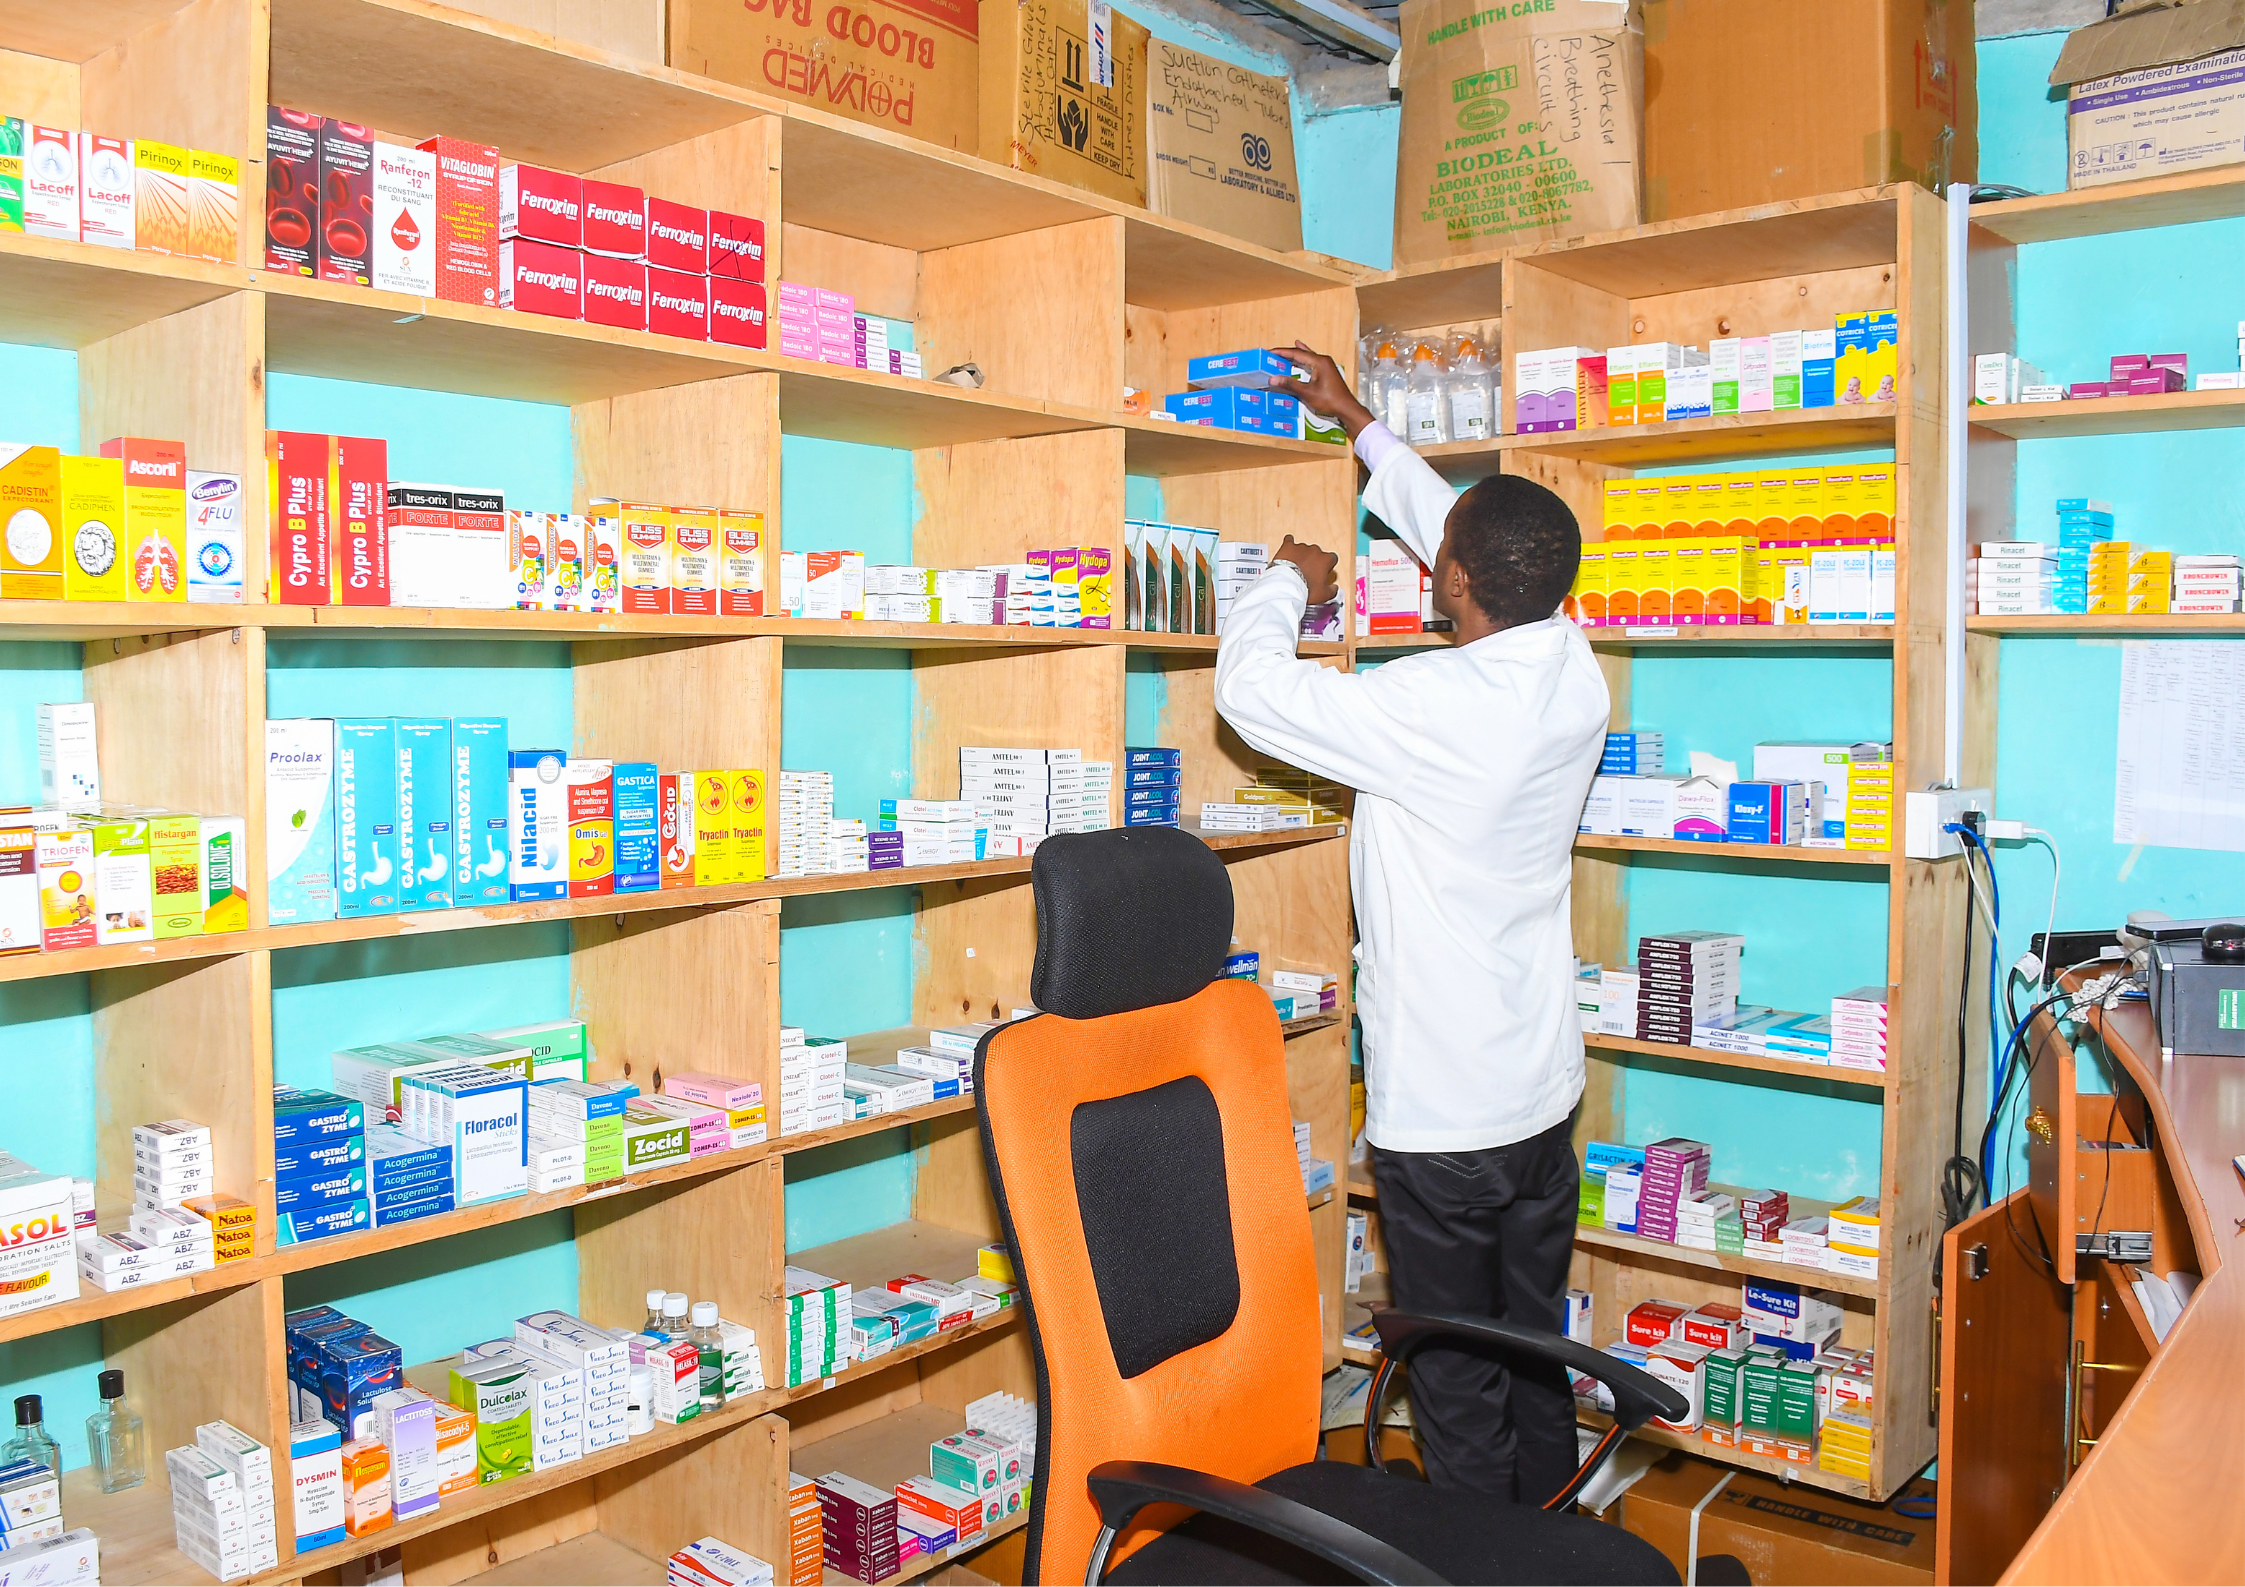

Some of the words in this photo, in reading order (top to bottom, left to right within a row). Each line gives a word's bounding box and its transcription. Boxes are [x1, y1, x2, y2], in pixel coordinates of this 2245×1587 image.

[1428, 18, 1468, 45] HANDLE
[1470, 6, 1506, 29] WITH
[1512, 0, 1556, 19] CARE
[826, 5, 935, 69] BLOOD
[765, 35, 836, 64] DEVICES
[850, 60, 914, 90] MEDICAL
[2078, 80, 2109, 94] Latex
[2112, 66, 2172, 86] Powdered
[762, 48, 914, 126] POLYMED
[1559, 37, 1588, 142] Breathing
[2093, 94, 2114, 106] Single
[2115, 92, 2128, 102] Use
[2140, 82, 2190, 96] Ambidextrous
[2202, 72, 2244, 84] Non-Sterile
[1097, 96, 1118, 114] FRAGILE
[1152, 102, 1166, 112] BOX
[2095, 114, 2126, 124] CAUTION
[2133, 110, 2146, 118] This
[2149, 106, 2176, 116] product
[2178, 100, 2208, 110] contains
[2210, 94, 2234, 104] natural
[1096, 113, 1118, 130] HANDLE
[2132, 120, 2152, 128] which
[2155, 118, 2168, 126] may
[2172, 114, 2192, 122] cause
[2194, 108, 2220, 118] allergic
[1101, 126, 1114, 139] WITH
[1445, 140, 1452, 152] A
[1454, 128, 1506, 149] PRODUCT
[1518, 121, 1538, 135] OF:
[1100, 136, 1115, 151] CARE
[140, 149, 183, 172] Pirinox
[1010, 140, 1038, 168] MEYER
[1094, 150, 1109, 164] KEEP
[1108, 158, 1120, 170] DRY
[1437, 140, 1558, 178] BIODEAL
[192, 158, 234, 182] Pirinox
[380, 160, 431, 180] Ranferon
[1430, 164, 1536, 194] LABORATORIES
[1538, 157, 1573, 174] LTD.
[2074, 170, 2093, 178] MADE
[2102, 162, 2137, 174] THAILAND
[30, 179, 75, 196] Lacoff
[378, 184, 434, 201] RECONSTITUANT
[406, 178, 422, 190] -12
[1220, 175, 1258, 193] LABORATORY
[1259, 184, 1266, 194] &
[1266, 186, 1285, 200] ALLIED
[1284, 191, 1296, 202] LTD
[1428, 196, 1450, 208] P.O.
[1453, 189, 1480, 204] BOX
[1483, 182, 1522, 198] 32040
[1534, 170, 1576, 187] 00600
[88, 187, 132, 205] Lacoff
[390, 194, 402, 202] DU
[404, 196, 422, 206] SANG
[521, 190, 578, 216] Ferroxim
[1508, 194, 1518, 206] &
[586, 203, 642, 226] Ferroxim
[1447, 212, 1510, 232] NAIROBI,
[1518, 198, 1572, 218] KENYA.
[651, 221, 704, 246] Ferroxim
[1483, 214, 1572, 236] info@biodeal.co.ke
[1836, 328, 1866, 338] COTRICEL
[1804, 342, 1832, 351] Biotrim
[1208, 357, 1239, 370] CEREBEST
[130, 460, 176, 477] Ascoril
[2, 484, 49, 498] CADISTIN
[196, 482, 235, 499] Benylin
[288, 477, 306, 516] Plus
[2, 496, 54, 504] EXPECTORANT
[69, 502, 116, 512] CADIPHEN
[349, 481, 366, 519] Plus
[406, 494, 448, 506] tres-orix
[458, 497, 498, 510] tres-orix
[288, 518, 306, 530] B
[407, 512, 448, 524] FORTE
[458, 516, 500, 528] FORTE
[318, 512, 326, 542] Appetite
[350, 522, 366, 534] B
[288, 535, 312, 586] Cypro
[350, 537, 372, 588] Cypro
[1079, 553, 1108, 570] Hydopa
[318, 576, 326, 587] An
[270, 752, 322, 764] Proolax
[617, 776, 656, 786] GASTICA
[342, 748, 357, 892] GASTROZYME
[400, 748, 414, 888] GASTROZYME
[154, 828, 196, 840] Histargan
[521, 788, 538, 868] Nilacid
[575, 828, 598, 838] Omis
[698, 830, 729, 841] Tryactin
[733, 827, 762, 838] Tryactin
[42, 846, 90, 857] TRIOFEN
[210, 844, 232, 890] OLSOLONE
[308, 1113, 346, 1128] GASTRO
[322, 1122, 348, 1134] ZYME
[465, 1112, 518, 1136] Floracol
[634, 1130, 684, 1156] Zocid
[384, 1150, 438, 1170] Acogermina
[384, 1168, 438, 1186] Acogermina
[218, 1214, 253, 1227] Natoa
[216, 1230, 251, 1244] Natoa
[1784, 1233, 1815, 1244] LOOBITOSS
[44, 1240, 71, 1252] SALTS
[6, 1274, 48, 1292] FLAVOUR
[1748, 1288, 1782, 1304] Le-Sure
[1783, 1298, 1796, 1310] Kit
[1631, 1324, 1650, 1334] Sure
[1652, 1327, 1666, 1338] kit
[362, 1385, 392, 1398] Lactulose
[480, 1386, 528, 1410] Dulcolax
[395, 1407, 433, 1424] LACTITOSS
[487, 1406, 504, 1414] COATED
[504, 1401, 522, 1411] TABLETS
[436, 1422, 470, 1440] Bisacodyl-5
[512, 1432, 528, 1443] relief
[296, 1469, 337, 1486] DYSMIN
[794, 1514, 811, 1526] Xaban
[1755, 1500, 1809, 1520] HANDLE
[1819, 1512, 1857, 1530] WITH
[1862, 1524, 1906, 1542] CARE
